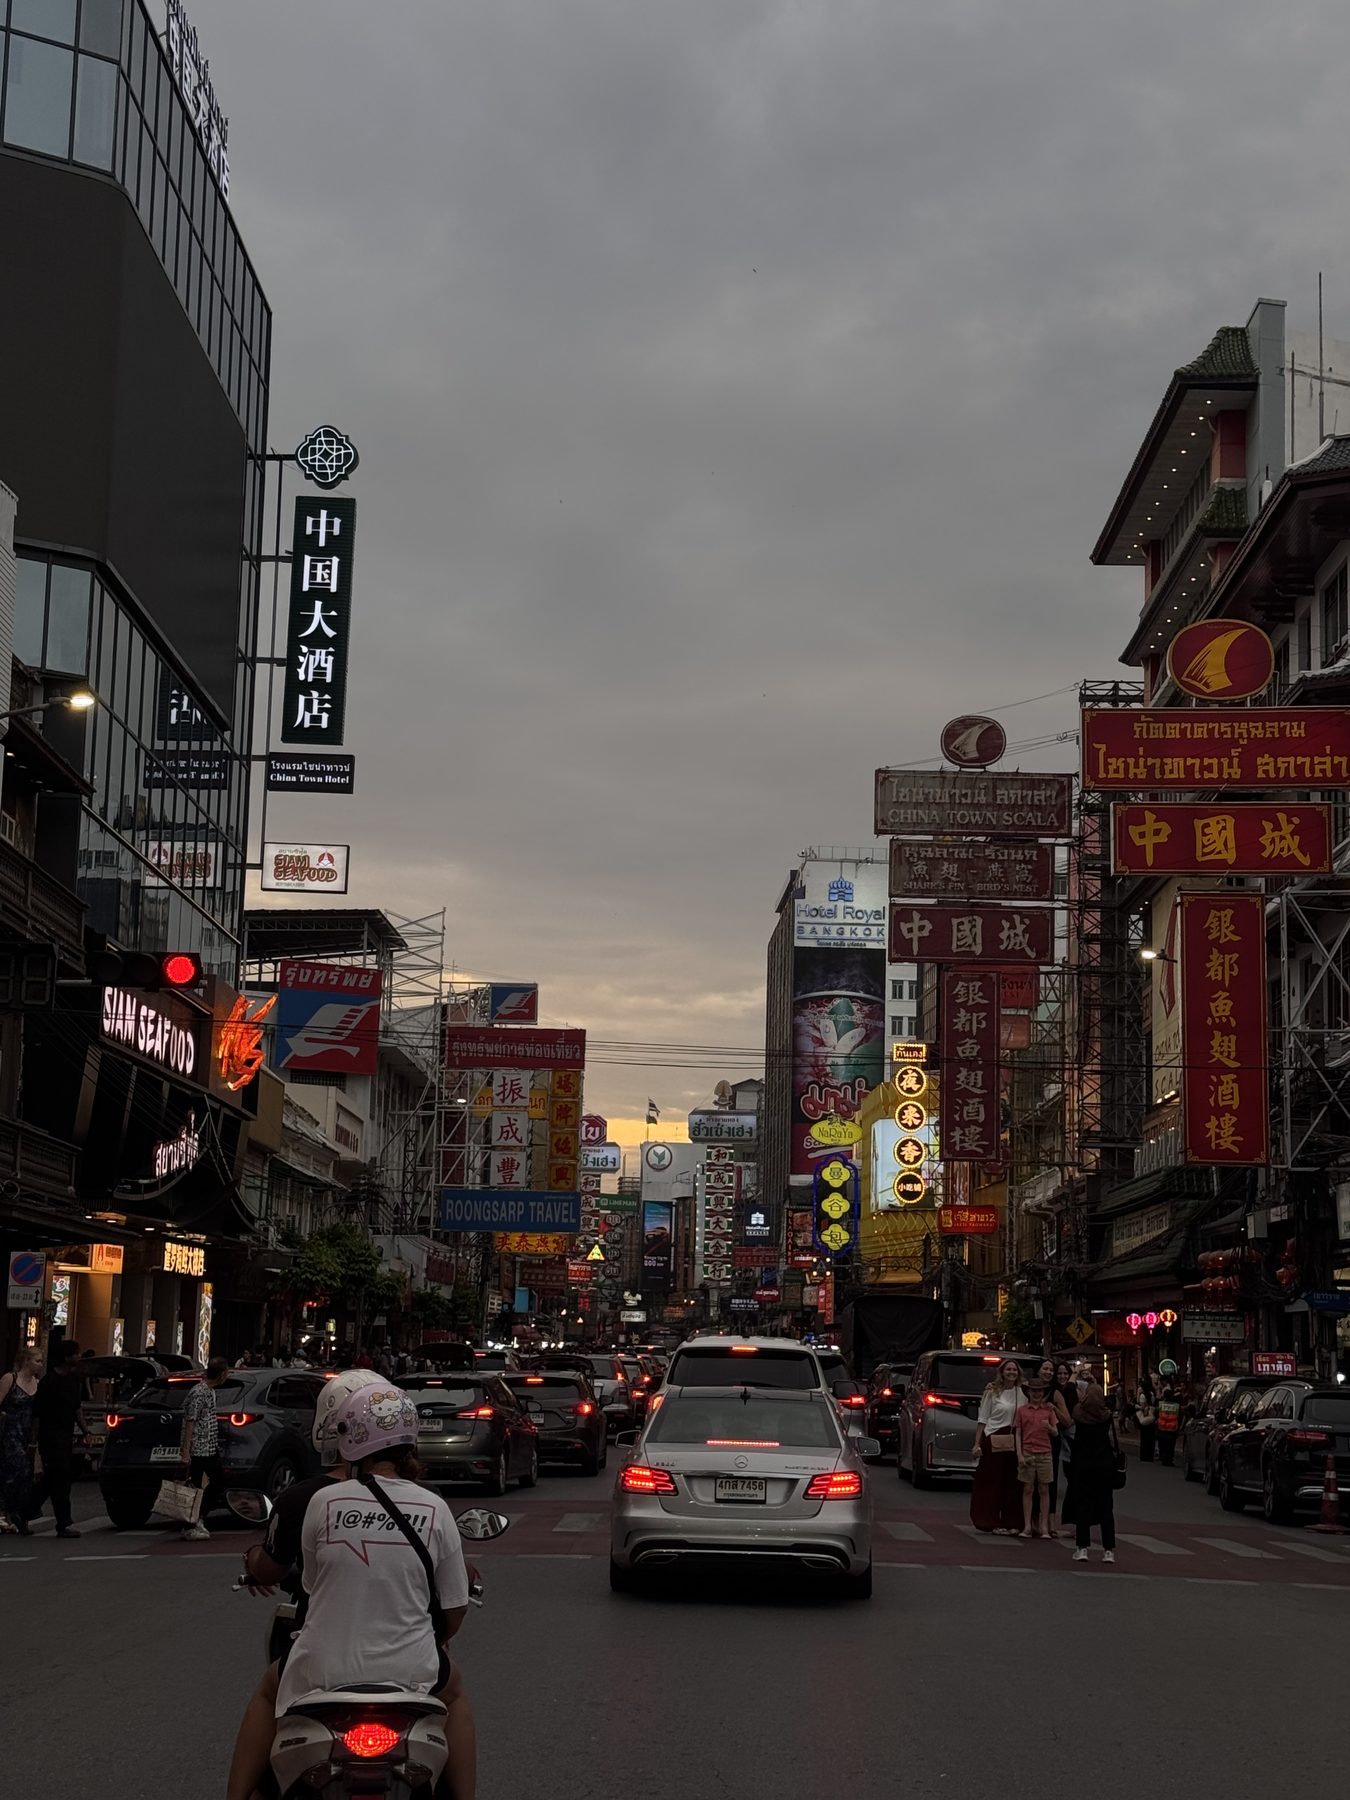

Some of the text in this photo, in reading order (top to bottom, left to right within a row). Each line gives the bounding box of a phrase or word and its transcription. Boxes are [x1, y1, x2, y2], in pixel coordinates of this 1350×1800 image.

[293, 509, 342, 729] 中国大酒店
[1132, 715, 1306, 745] ภัตตาคารหูฉลาม
[270, 760, 351, 772] โรงแรมไชน่าทาวน์
[1092, 743, 1350, 779] ไชน่าทาวน์ สกาล่า
[270, 773, 350, 784] China Town Hotel
[888, 810, 1059, 827] CHINA TOWN SCALA
[1128, 810, 1311, 867] 中國城
[274, 854, 311, 868] SIAM
[273, 867, 338, 882] SEAFOOD
[903, 881, 945, 890] SHARK'S
[948, 882, 966, 890] FIN
[976, 883, 1010, 891] BIRD'S
[1012, 884, 1040, 893] NEST
[796, 904, 885, 923] Hotel Royal
[796, 926, 885, 937] BANGKOK
[899, 908, 1038, 959] 中國城
[286, 963, 378, 988] รุ่งทรัพย์
[103, 986, 195, 1075] SIAM SEAFOOD
[1202, 907, 1244, 1154] 銀都魚翅酒樓
[950, 980, 990, 1154] 銀都魚翅酒樓
[496, 1076, 527, 1186] 振成豐
[692, 1119, 753, 1137] ฮั่วเซ่งเฮง
[818, 1127, 853, 1138] NaRaYa
[445, 1199, 577, 1223] ROONGSARP TRAVEL
[711, 1150, 728, 1279] 和成興大金行
[719, 1479, 764, 1490] 4กส 7456
